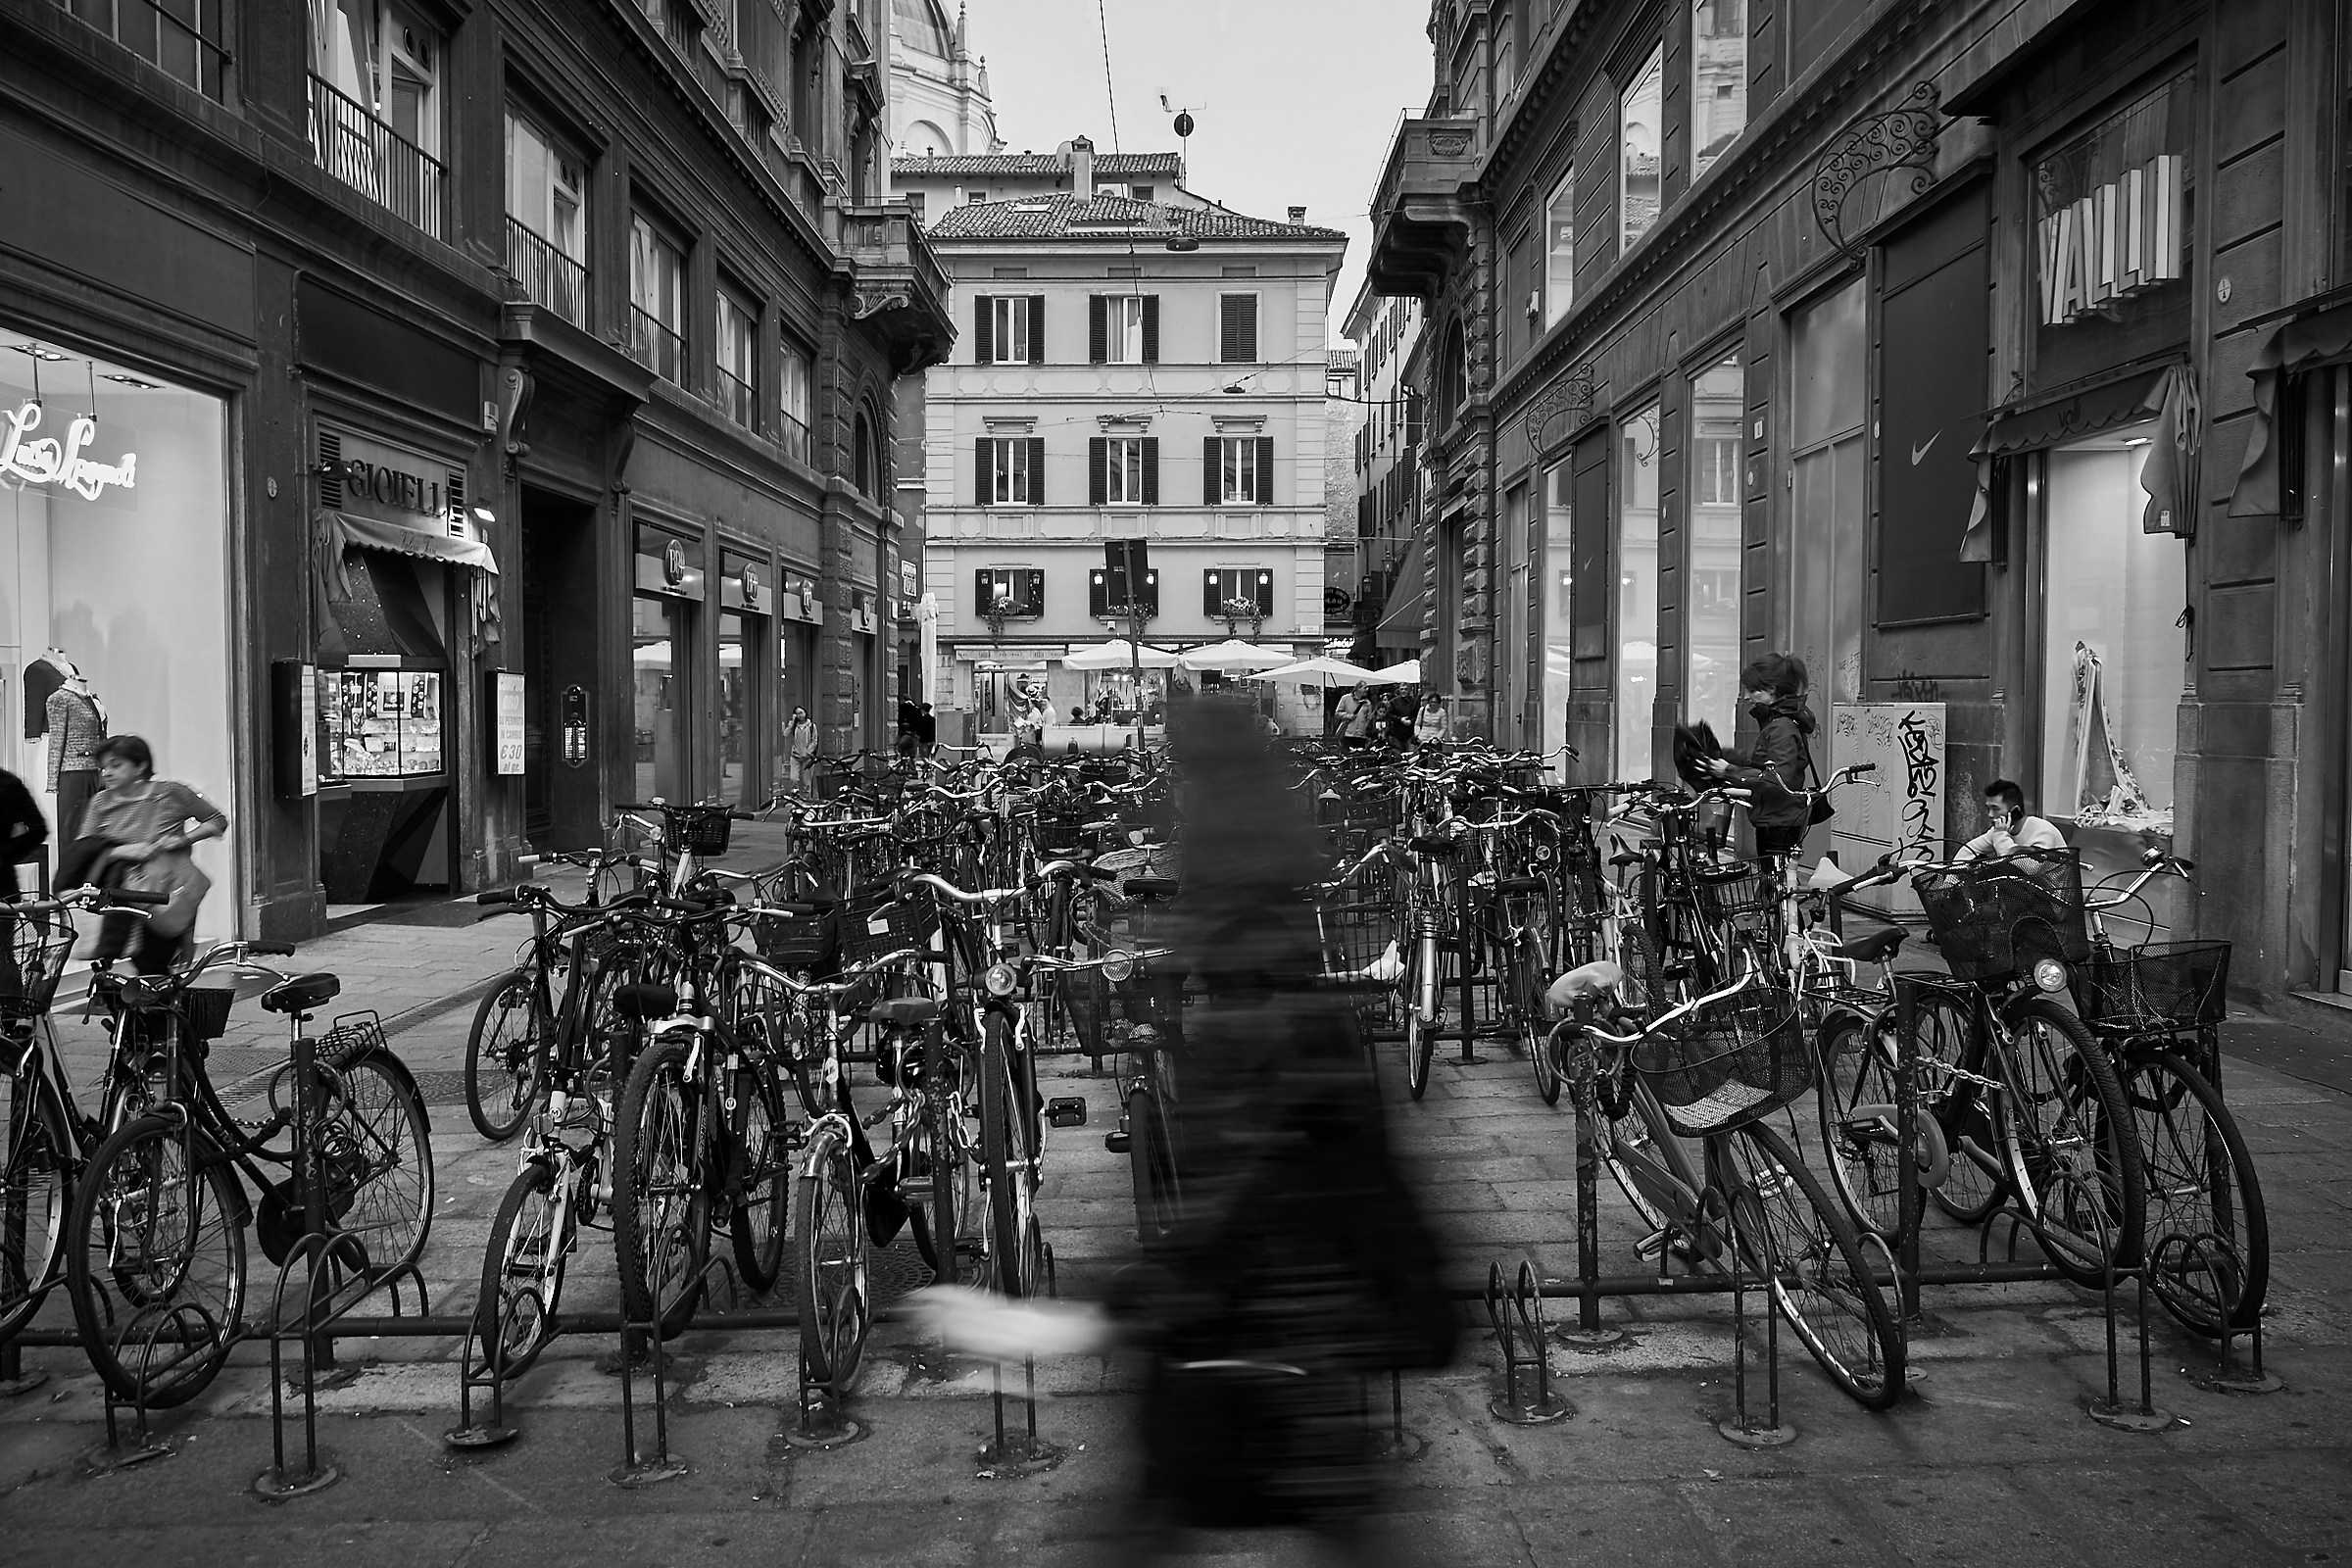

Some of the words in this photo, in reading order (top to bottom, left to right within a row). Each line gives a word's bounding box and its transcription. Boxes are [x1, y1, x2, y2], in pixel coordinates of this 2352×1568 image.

[2038, 154, 2182, 326] VALLI
[347, 459, 453, 520] GIOIELLI
[503, 694, 520, 710] ORO
[506, 715, 524, 726] PERMUTA
[507, 730, 522, 740] CAMBIO
